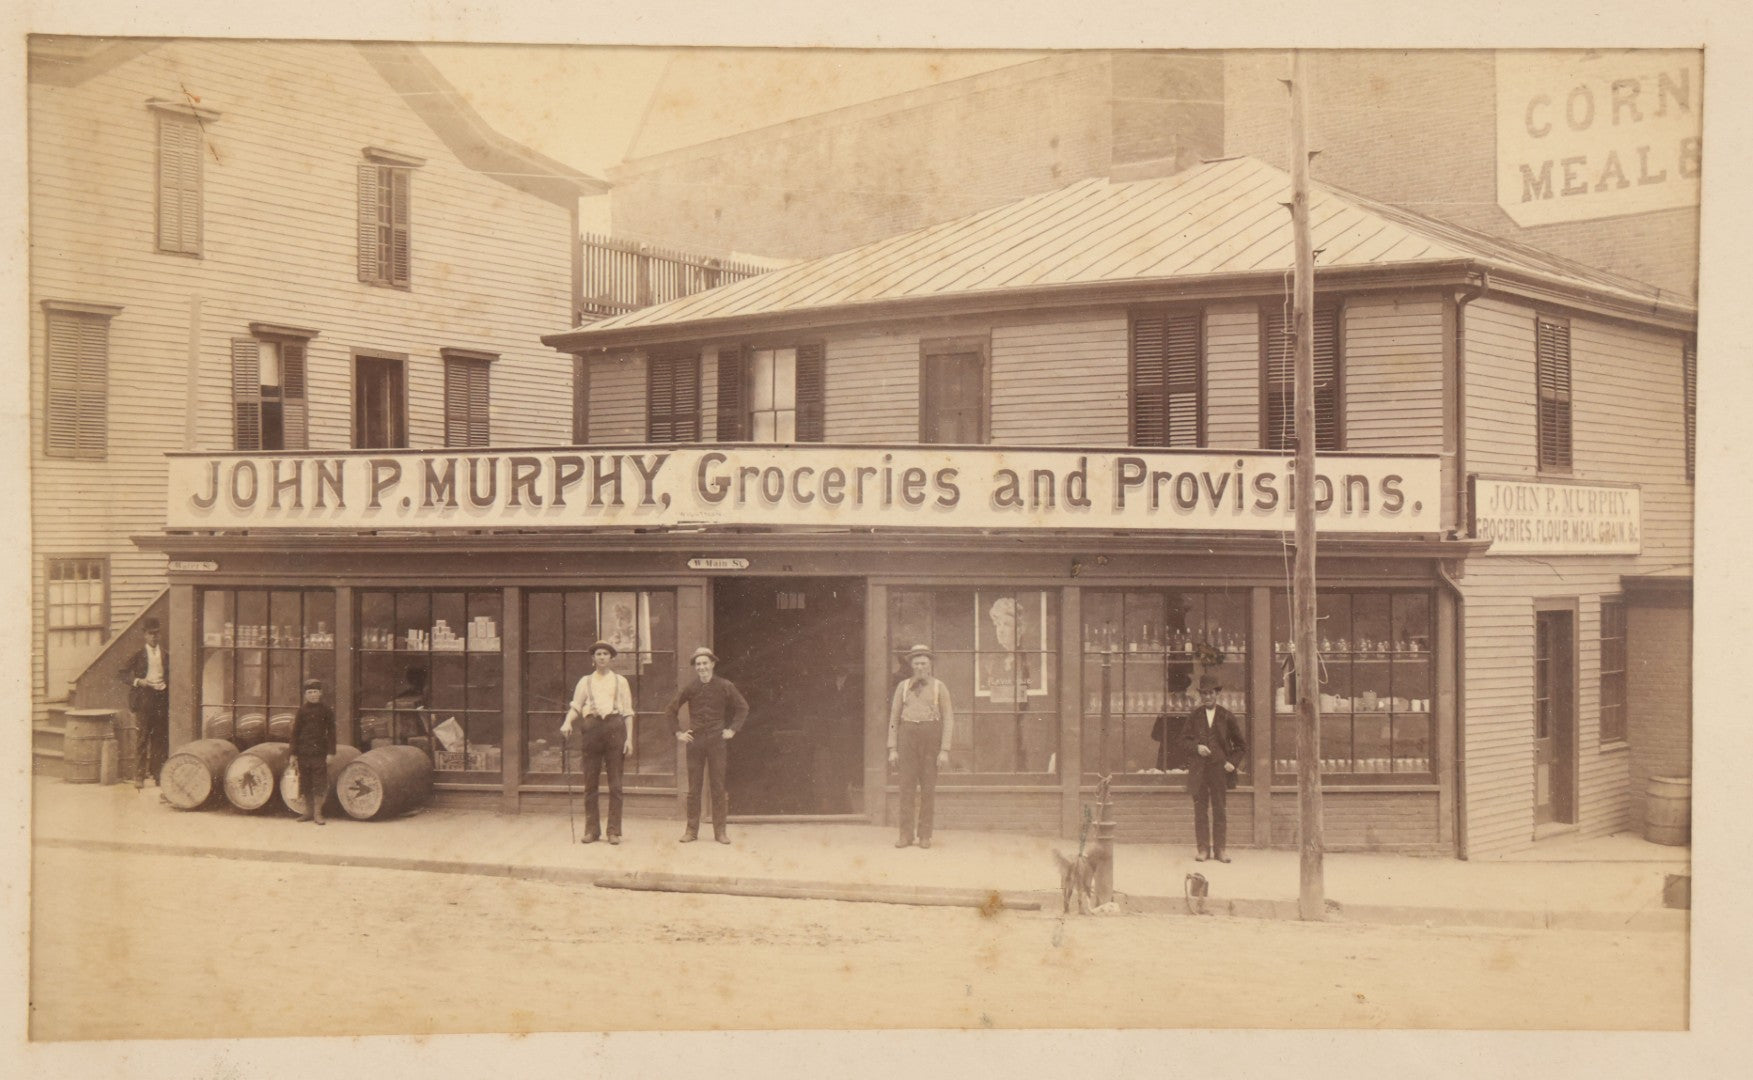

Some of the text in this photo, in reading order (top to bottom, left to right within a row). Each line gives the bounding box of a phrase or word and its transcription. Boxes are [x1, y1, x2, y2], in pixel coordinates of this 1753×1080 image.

[1524, 67, 1691, 139] CORN
[1518, 145, 1668, 204] MEAL
[191, 451, 1424, 513] JOHN P. MURPHY, Groceries and Provisions.
[1489, 484, 1541, 512] JOHN
[1545, 487, 1559, 513] P.
